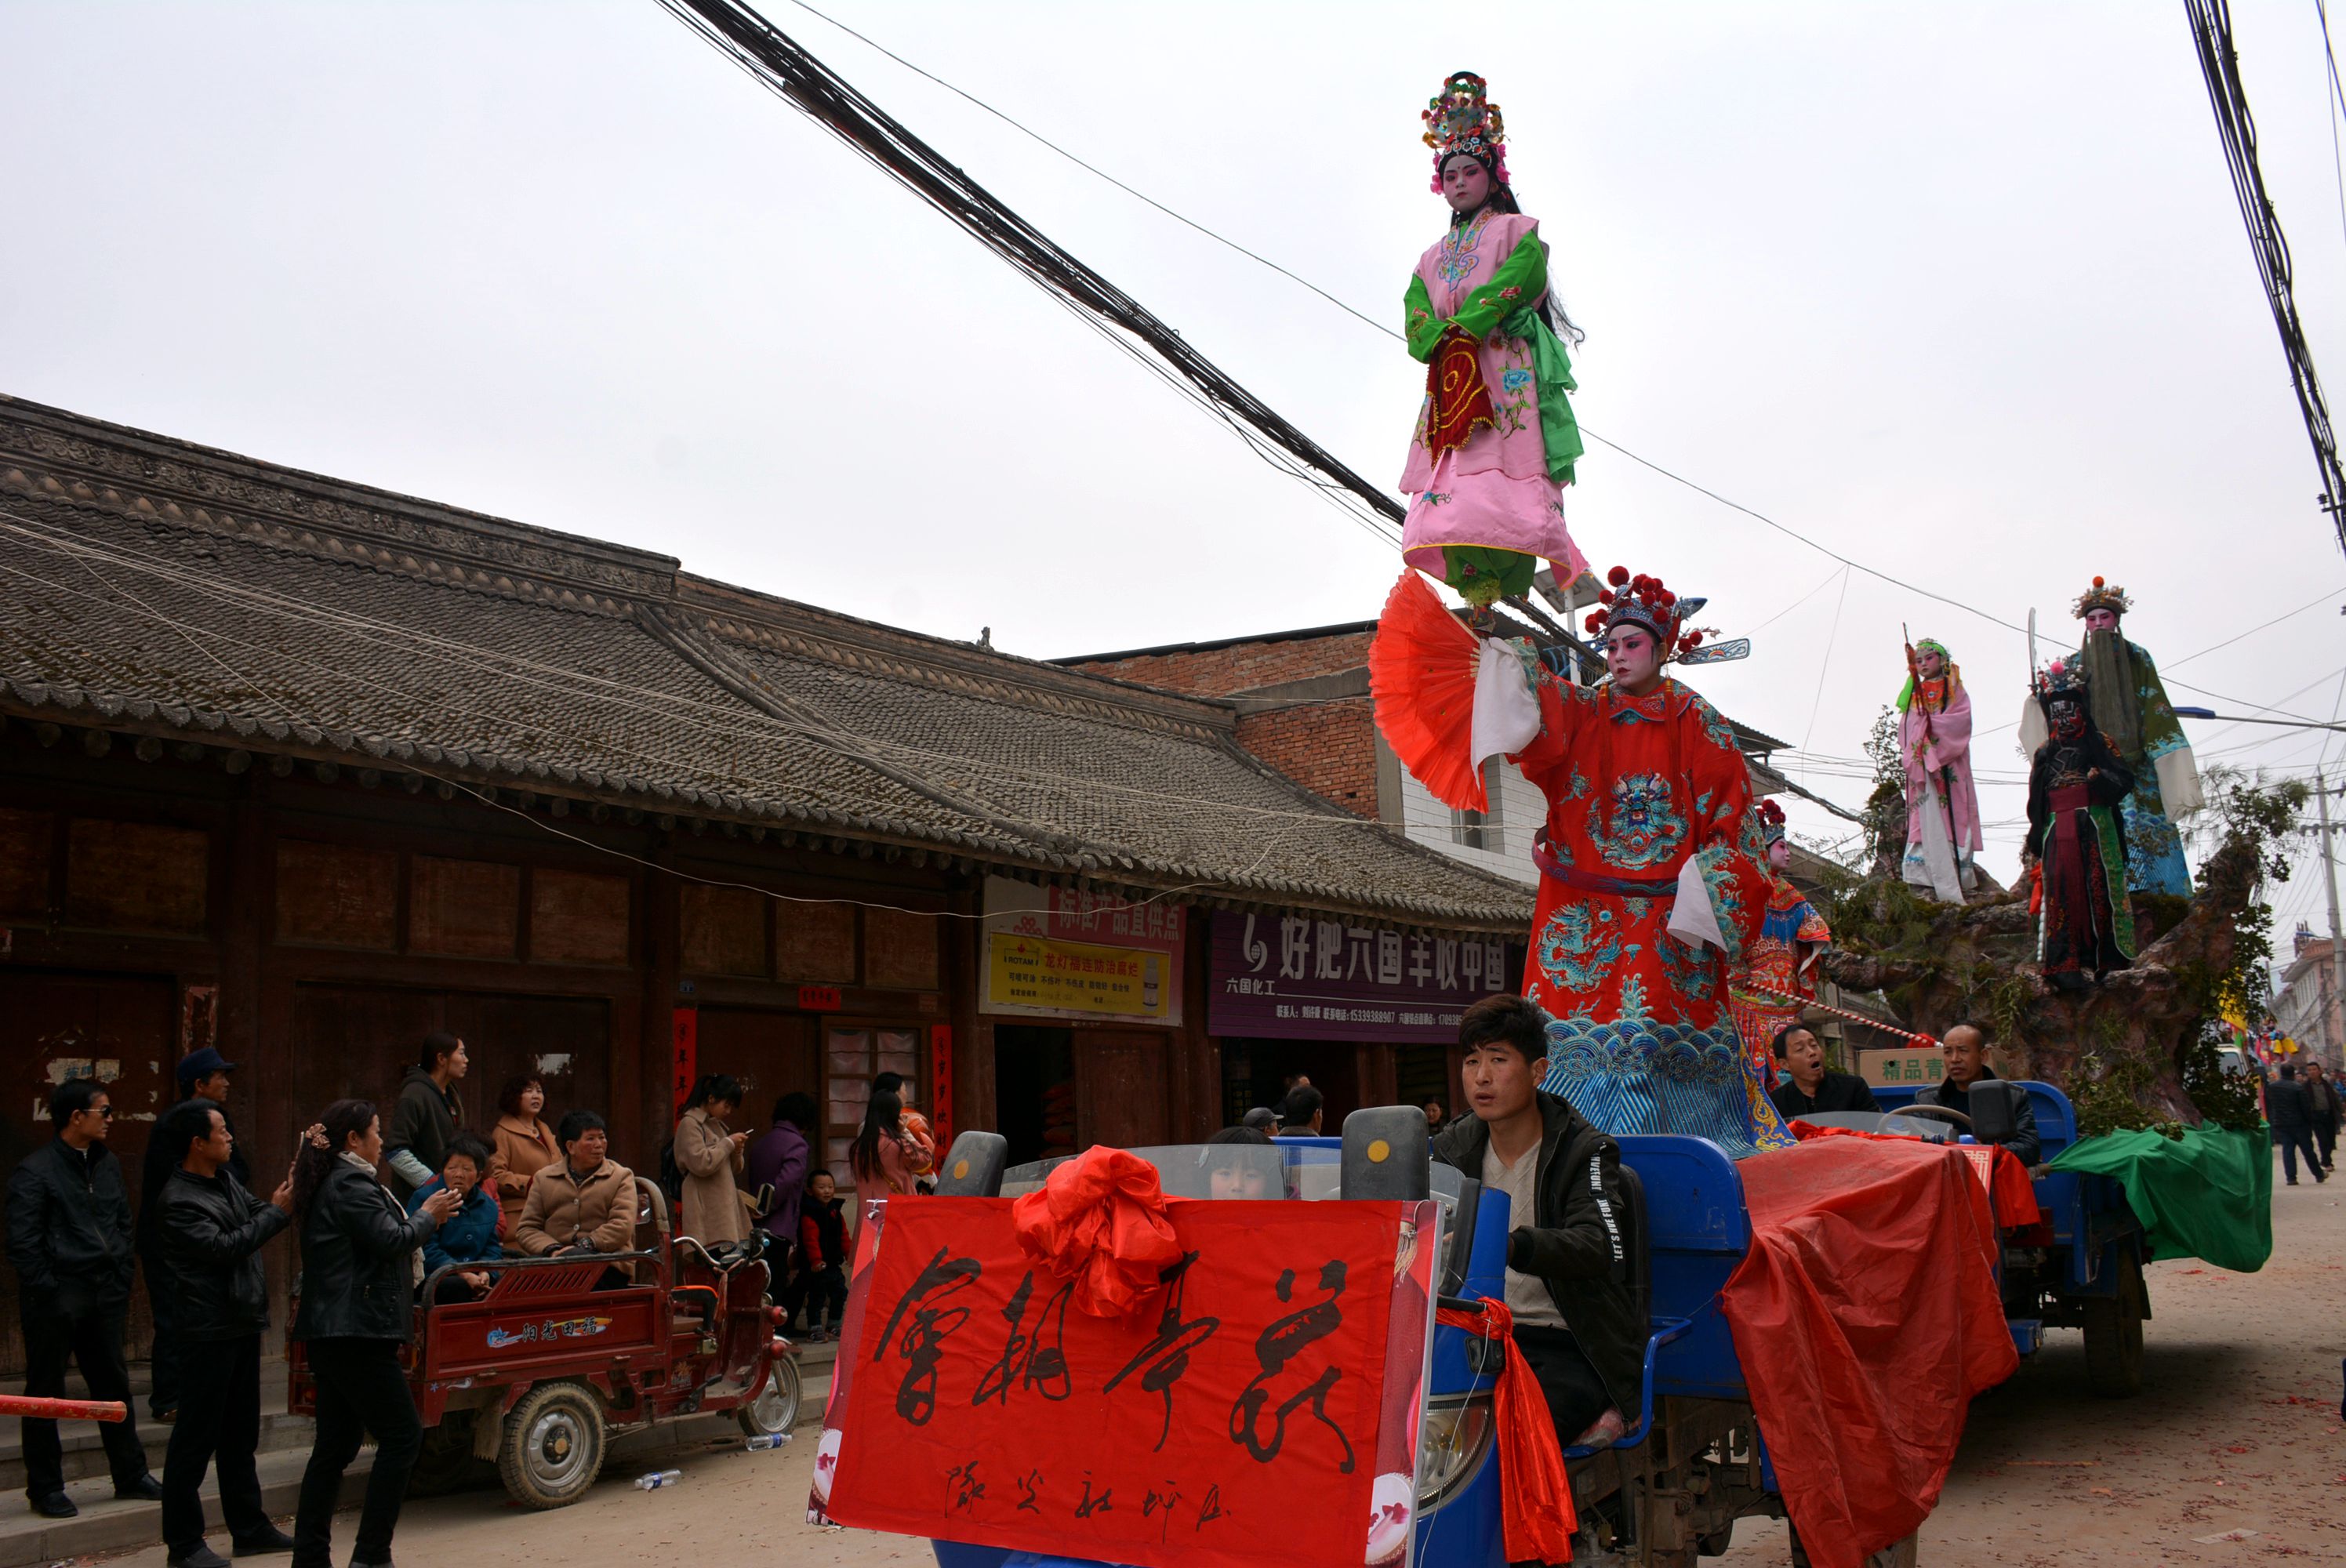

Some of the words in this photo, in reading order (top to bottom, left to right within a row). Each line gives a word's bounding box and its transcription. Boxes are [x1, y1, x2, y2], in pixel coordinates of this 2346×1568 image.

[1058, 888, 1180, 941] 标准产品直供点
[1008, 956, 1034, 967] ROTAM
[1226, 977, 1276, 996] 六国化工
